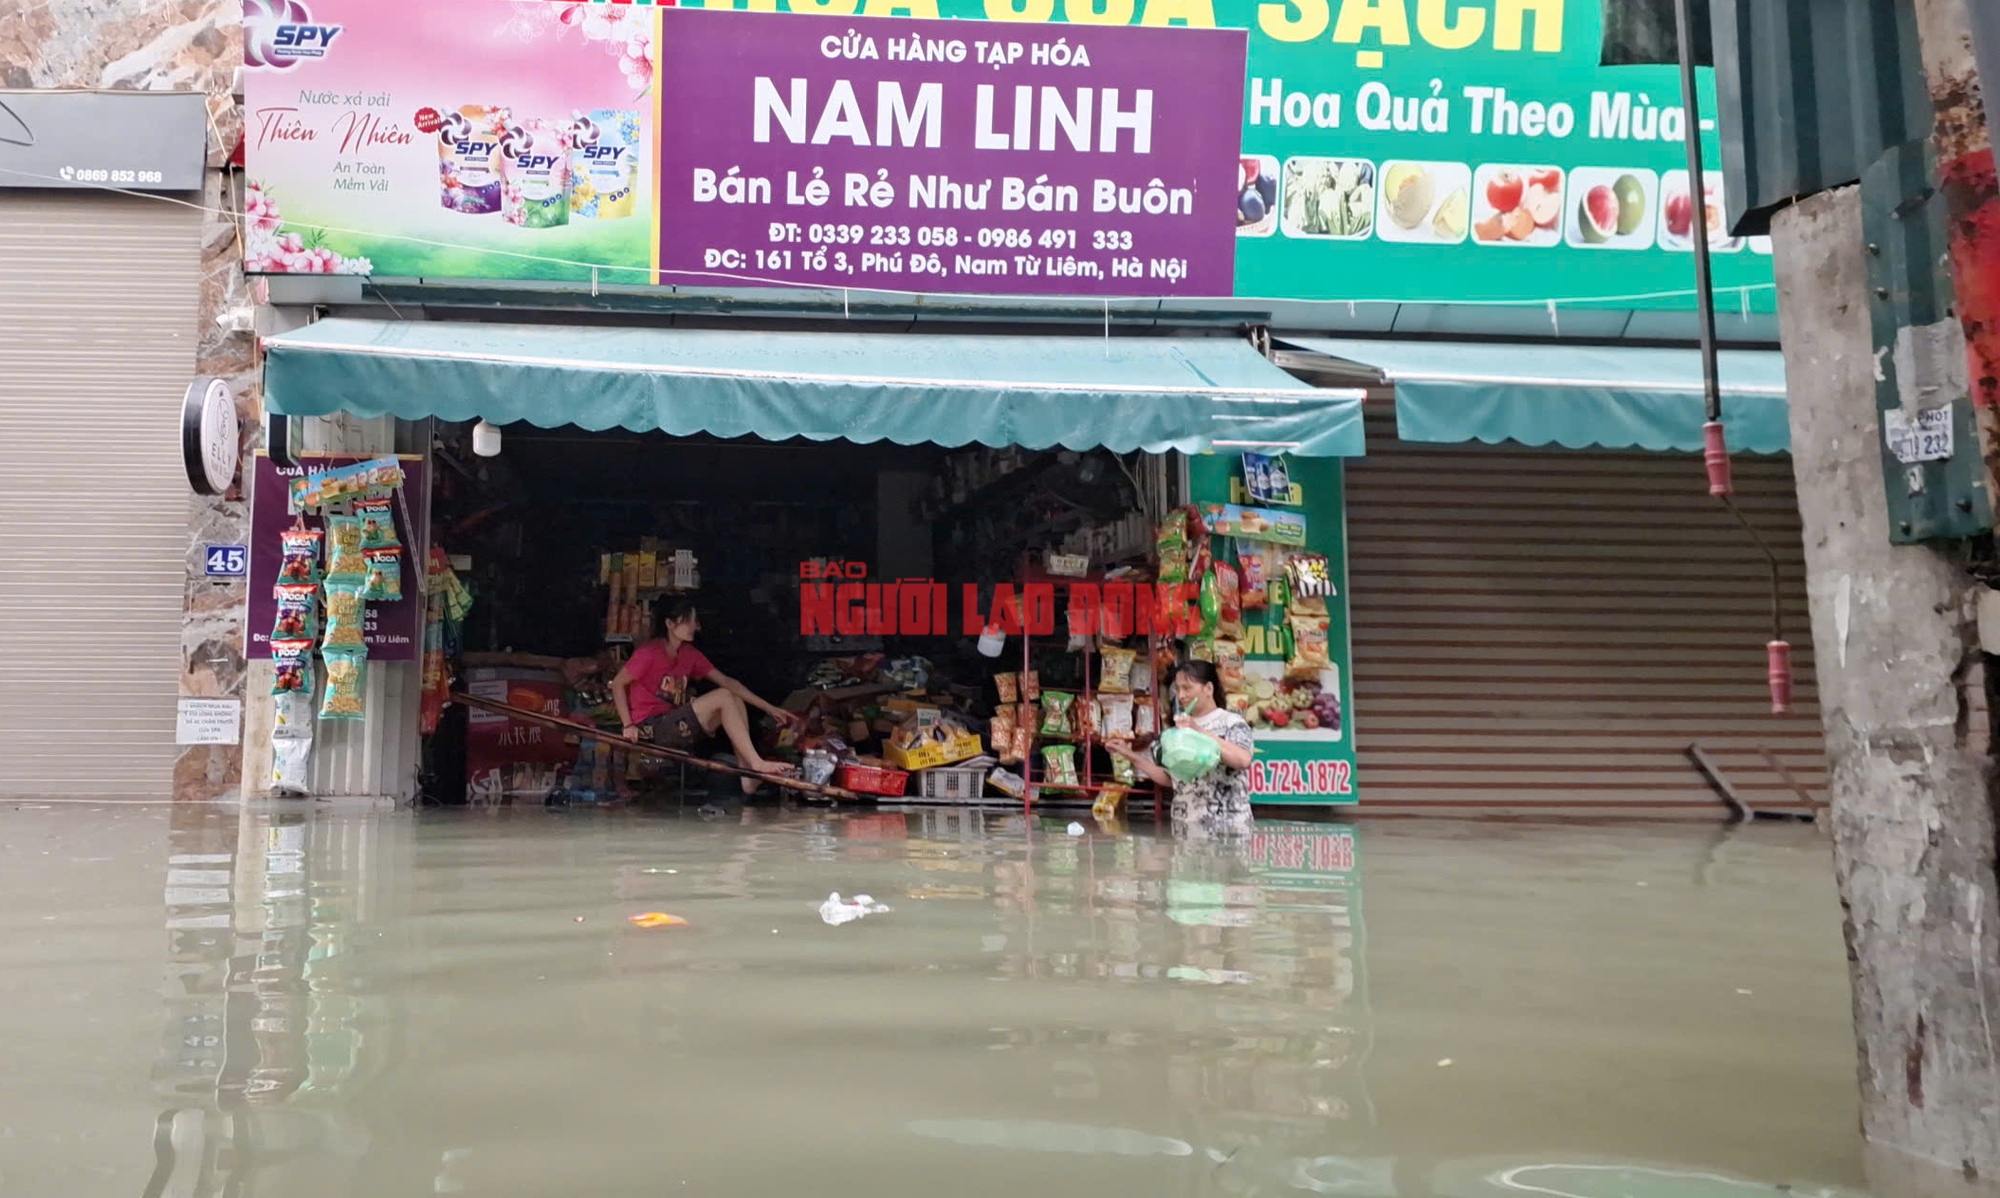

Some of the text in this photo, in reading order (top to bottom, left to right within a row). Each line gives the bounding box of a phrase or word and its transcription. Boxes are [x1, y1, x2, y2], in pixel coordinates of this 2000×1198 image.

[273, 25, 340, 47] SPY
[821, 28, 1091, 70] CỬA HÀNG TẠP HÓA
[299, 90, 340, 105] Nước
[344, 91, 363, 106] xả
[754, 76, 1153, 153] NAM LINH
[1250, 78, 1341, 128] Hoa
[1356, 78, 1449, 133] Quả
[1463, 86, 1574, 138] Theo
[1589, 90, 1686, 142] Mùa
[256, 107, 414, 154] Thiên Nhiên
[455, 142, 498, 155] SPY
[583, 146, 626, 159] SPY
[333, 162, 386, 174] An Toàn
[517, 156, 559, 169] SPY
[77, 169, 162, 182] 0869 852 968
[693, 165, 1193, 215] Bán Lẻ Rẻ Như Bán Buôn
[768, 222, 801, 242] ĐT:
[808, 223, 864, 244] 0339
[870, 225, 911, 246] 233
[917, 227, 958, 247] 058
[977, 228, 1032, 248] 0986
[1038, 229, 1076, 249] 491
[1092, 230, 1133, 250] 333
[704, 245, 1188, 283] ĐC: 161 Tổ 3, Phú Đô, Nam Từ Liêm, Hà Nội
[207, 550, 245, 571] 45
